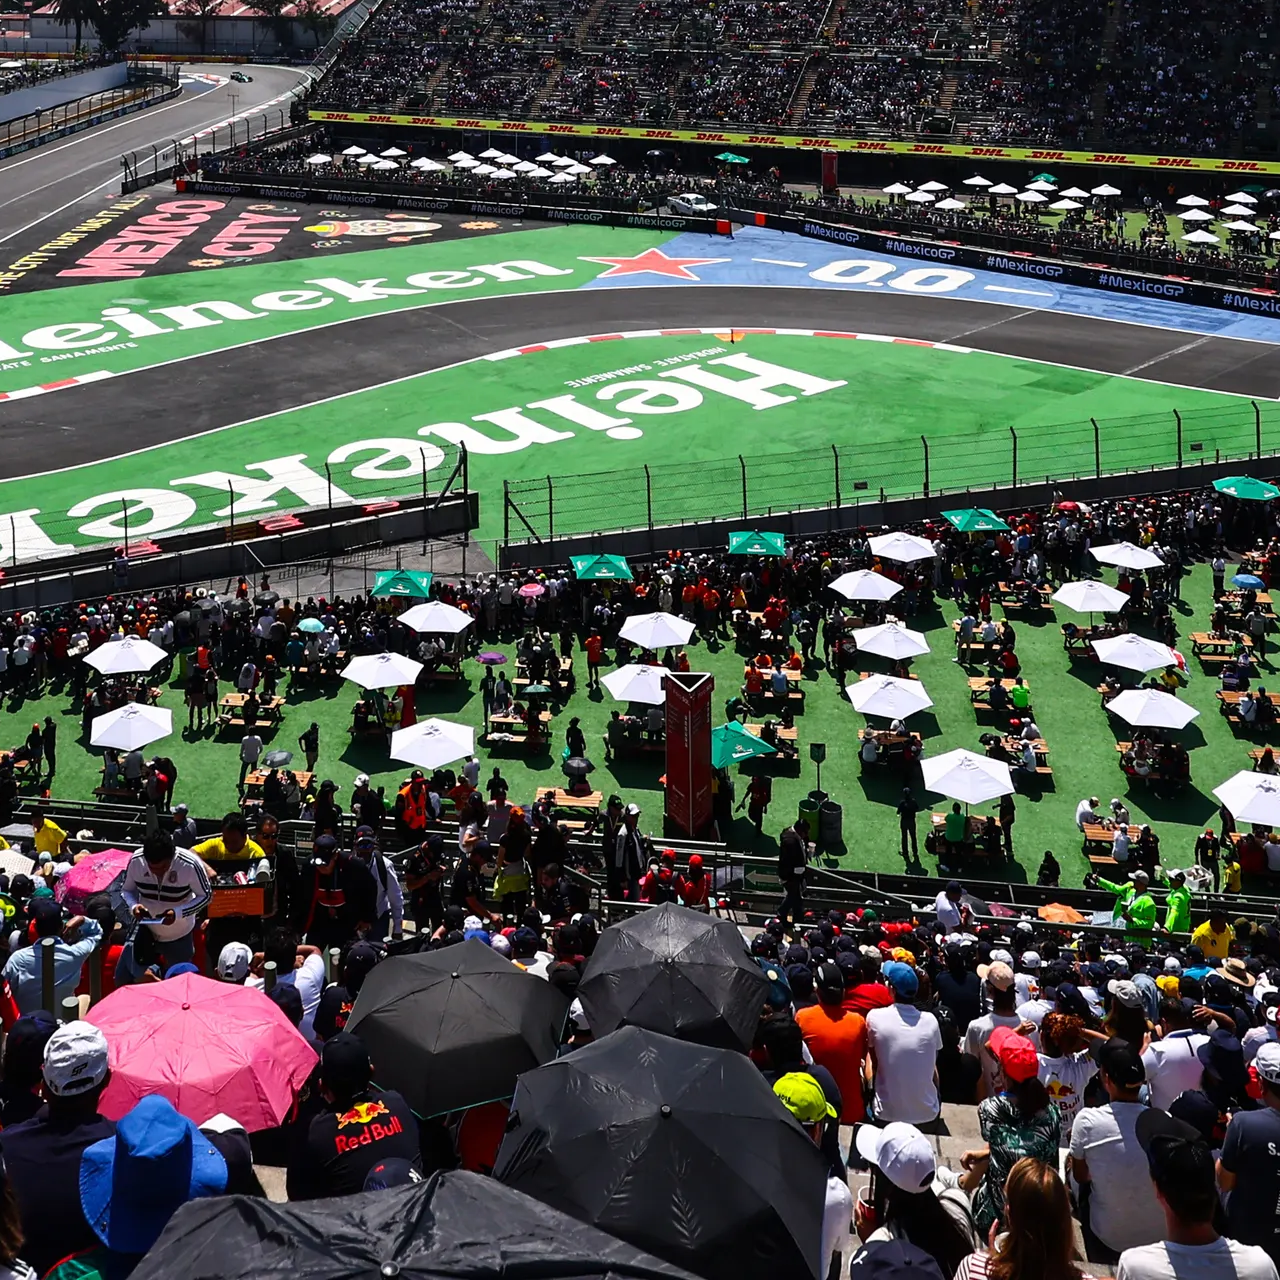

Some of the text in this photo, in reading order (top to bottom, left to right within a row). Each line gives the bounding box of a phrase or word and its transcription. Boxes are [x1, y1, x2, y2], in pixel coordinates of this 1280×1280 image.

[368, 115, 392, 123] DHL
[411, 117, 436, 125] DHL
[501, 123, 528, 131] DHL
[548, 125, 574, 133] DHL
[596, 127, 623, 135] DHL
[645, 130, 673, 138] DHL
[696, 132, 724, 141] DHL
[748, 135, 776, 144] DHL
[802, 138, 831, 147] DHL
[857, 141, 886, 150] DHL
[912, 144, 945, 154] DHL
[971, 147, 1004, 157] DHL
[1031, 150, 1065, 160] DHL
[1093, 154, 1127, 164] DHL
[1156, 157, 1192, 168] DHL
[1223, 161, 1260, 172] DHL
[195, 180, 241, 193] #MexicoGP
[260, 188, 307, 199] #MexicoGP
[327, 192, 376, 204] #MexicoGP
[397, 198, 448, 210] #MexicoGP
[471, 203, 525, 216] #MexicoGP
[548, 210, 603, 222] #MexicoGP
[627, 215, 685, 229] #MexicoGP
[9, 251, 56, 270] CITY
[39, 232, 88, 250] THAT
[72, 218, 112, 232] HAS
[96, 210, 124, 218] IT
[111, 196, 147, 211] ALL
[56, 199, 226, 277] MEXICO
[202, 211, 302, 258] CITY
[804, 222, 859, 243] #MexicoGP
[885, 240, 956, 261] #MexicoGP
[987, 254, 1064, 278] #MexicoGP
[1098, 273, 1184, 297] #MexicoGP
[40, 341, 138, 363] SANAMENTE
[563, 363, 652, 388] SANAMENTE
[335, 1115, 403, 1154] Red Bull
[1267, 1142, 1280, 1157] S.
